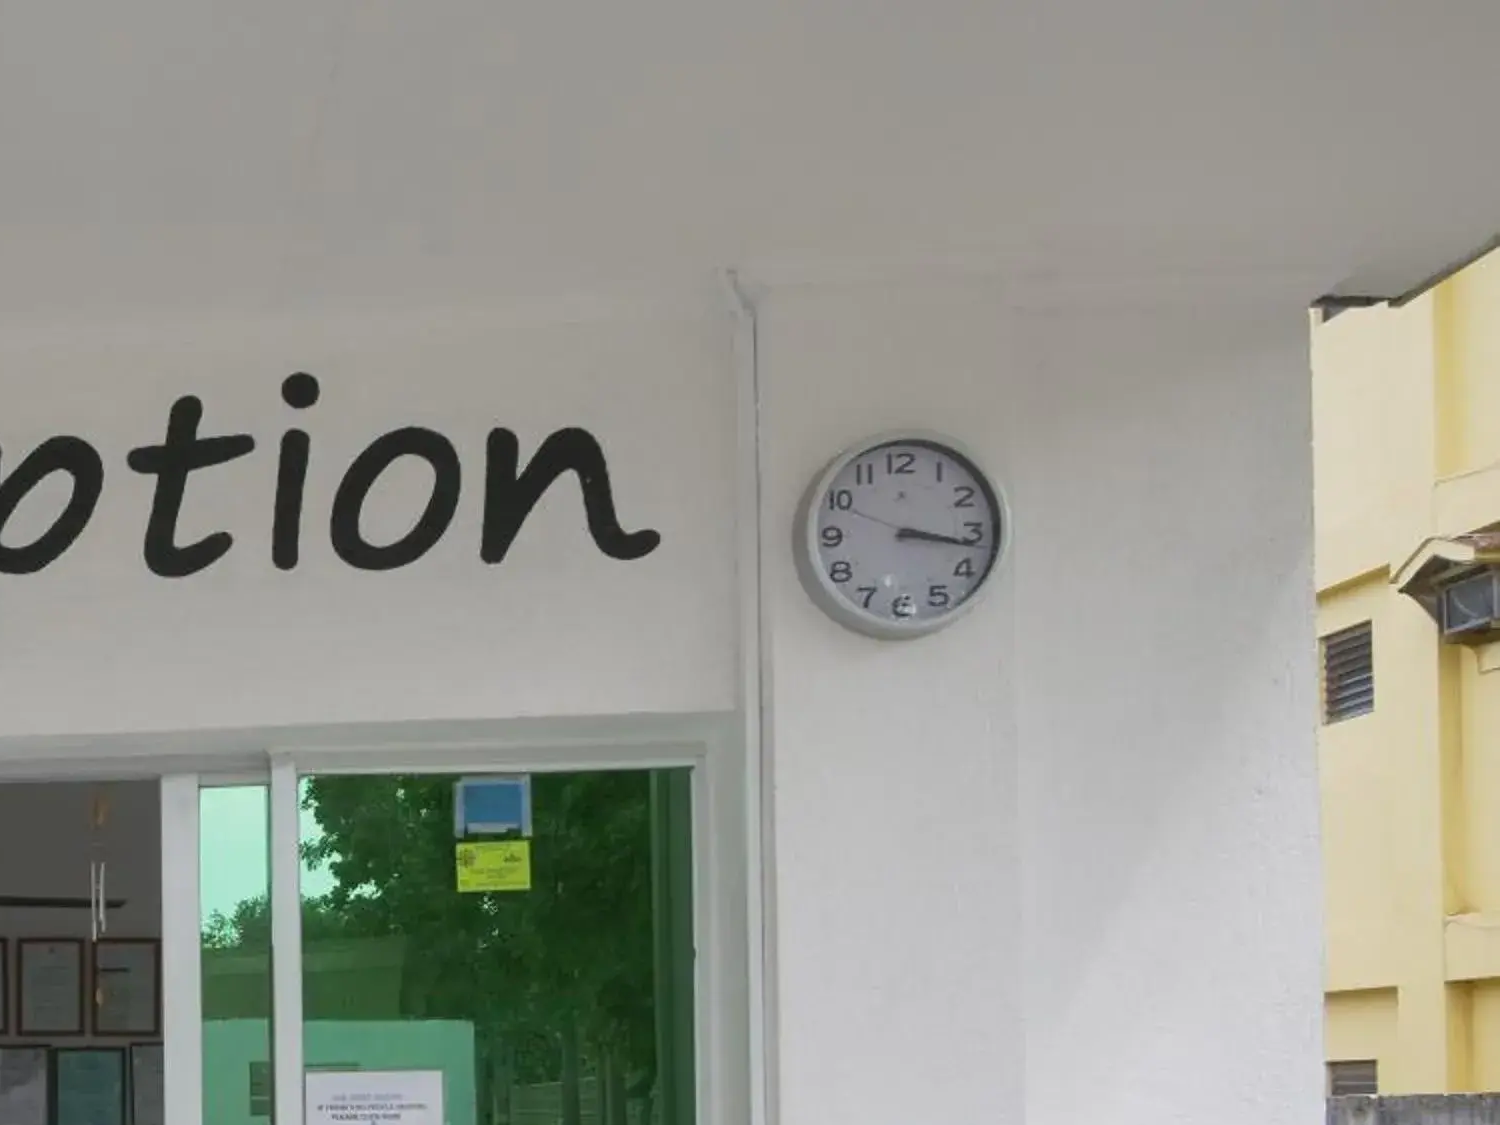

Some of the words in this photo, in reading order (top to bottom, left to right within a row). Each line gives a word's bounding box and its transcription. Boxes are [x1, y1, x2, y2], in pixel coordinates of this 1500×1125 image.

[856, 463, 873, 486] 11
[885, 452, 917, 475] 12
[936, 461, 943, 483] 1
[827, 488, 854, 511] 10
[953, 486, 976, 508] 2
[821, 526, 844, 548] 9
[962, 521, 984, 545] 3
[829, 560, 853, 584] 8
[952, 557, 976, 579] 4
[855, 586, 878, 609] 7
[891, 595, 916, 618] 6
[928, 584, 950, 608] 5
